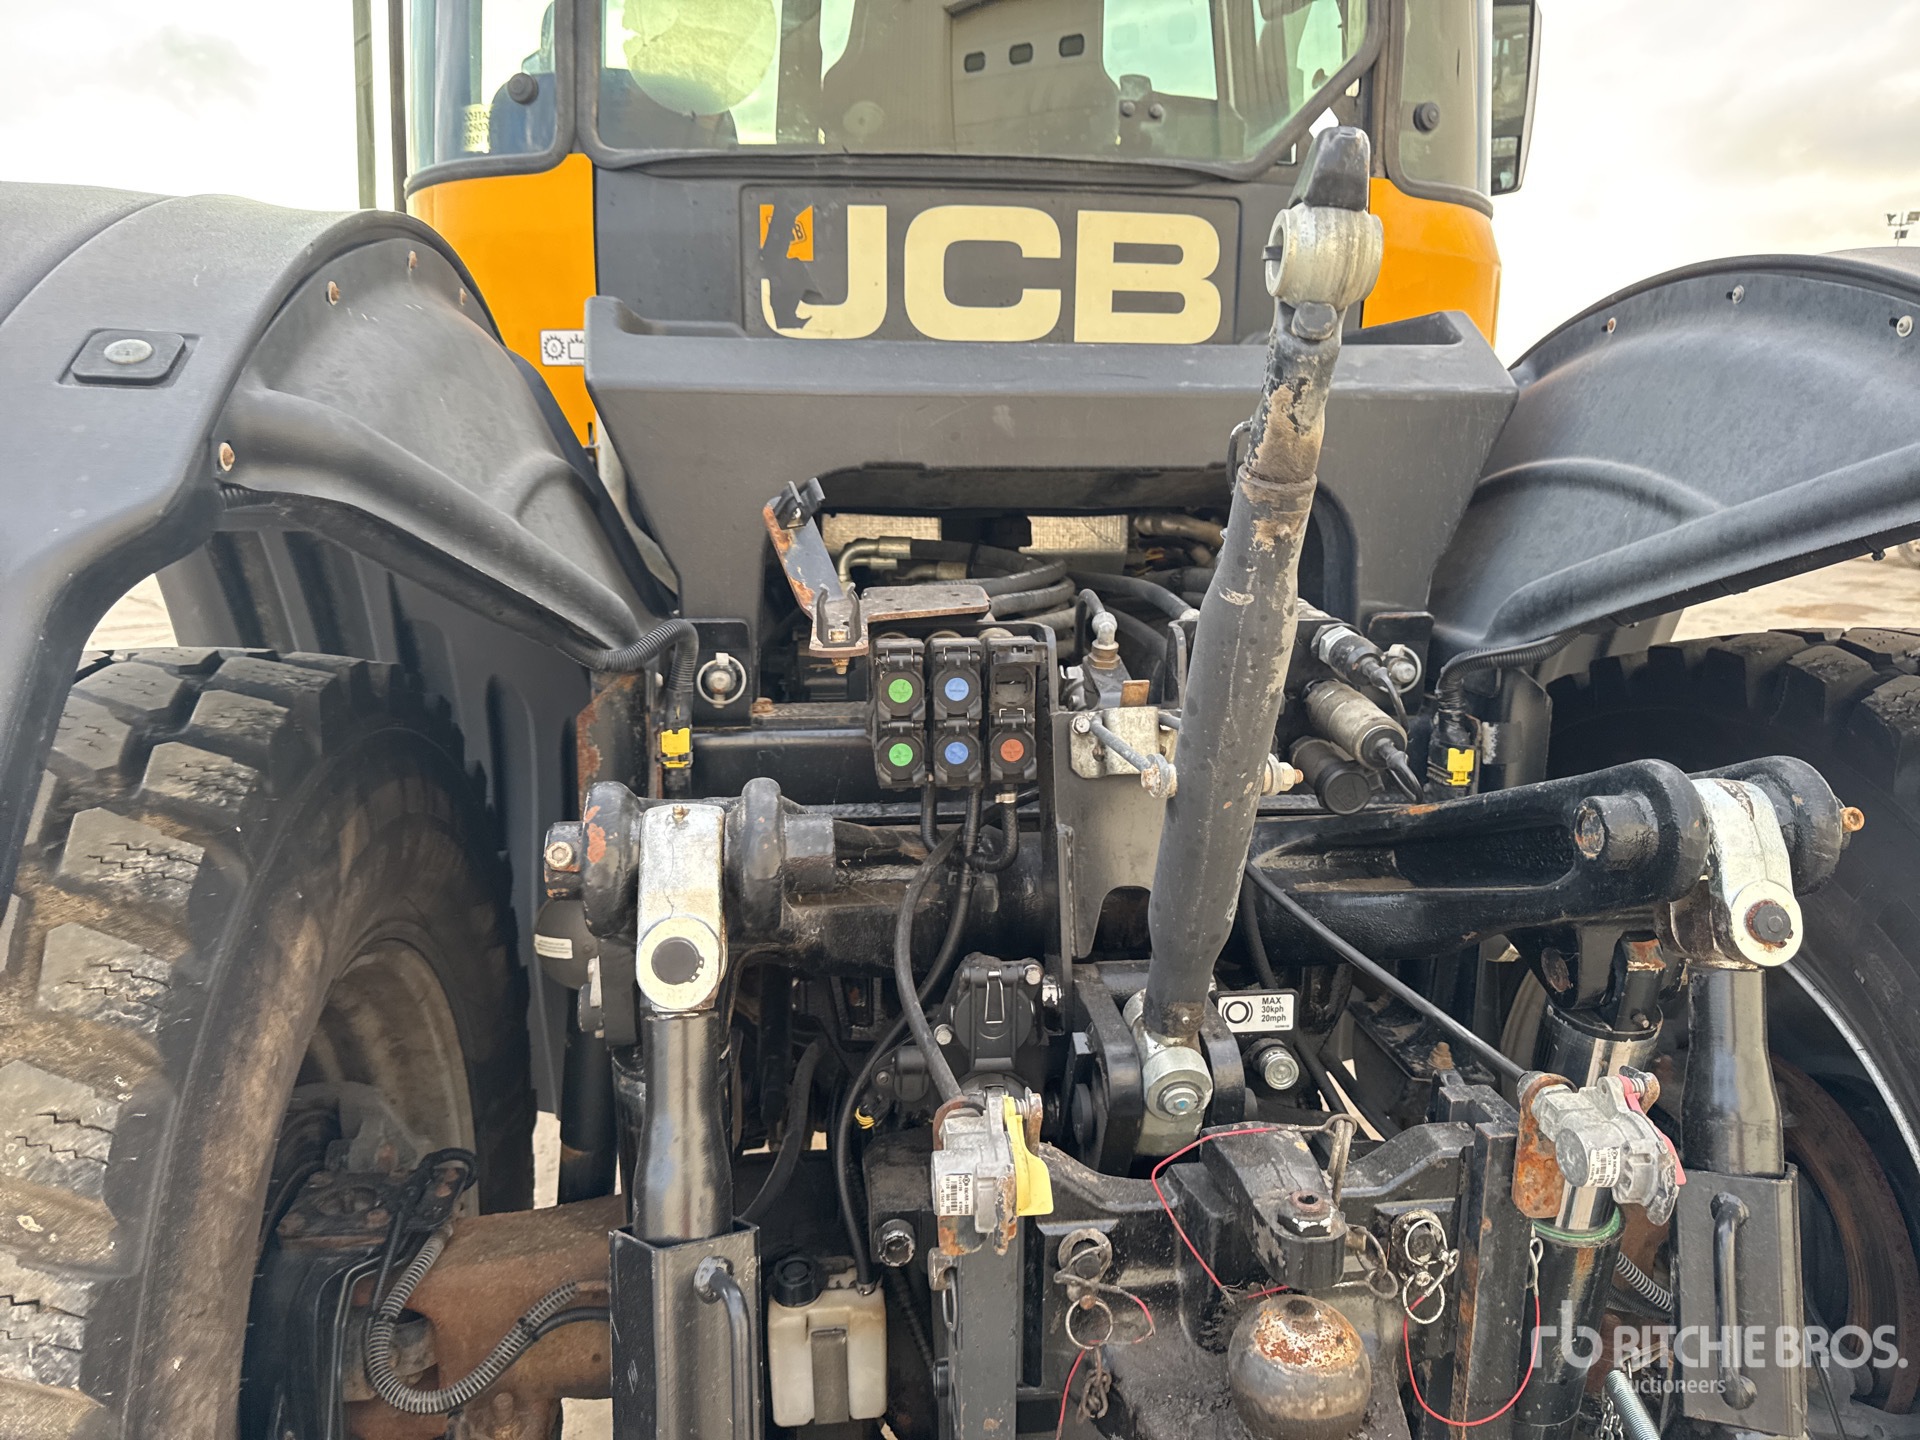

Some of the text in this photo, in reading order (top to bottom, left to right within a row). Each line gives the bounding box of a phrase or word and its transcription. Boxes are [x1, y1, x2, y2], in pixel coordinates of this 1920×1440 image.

[761, 204, 1221, 344] JCB
[1261, 996, 1282, 1005] MAX
[1261, 1005, 1284, 1014] 30kph
[1261, 1014, 1287, 1023] 20mph
